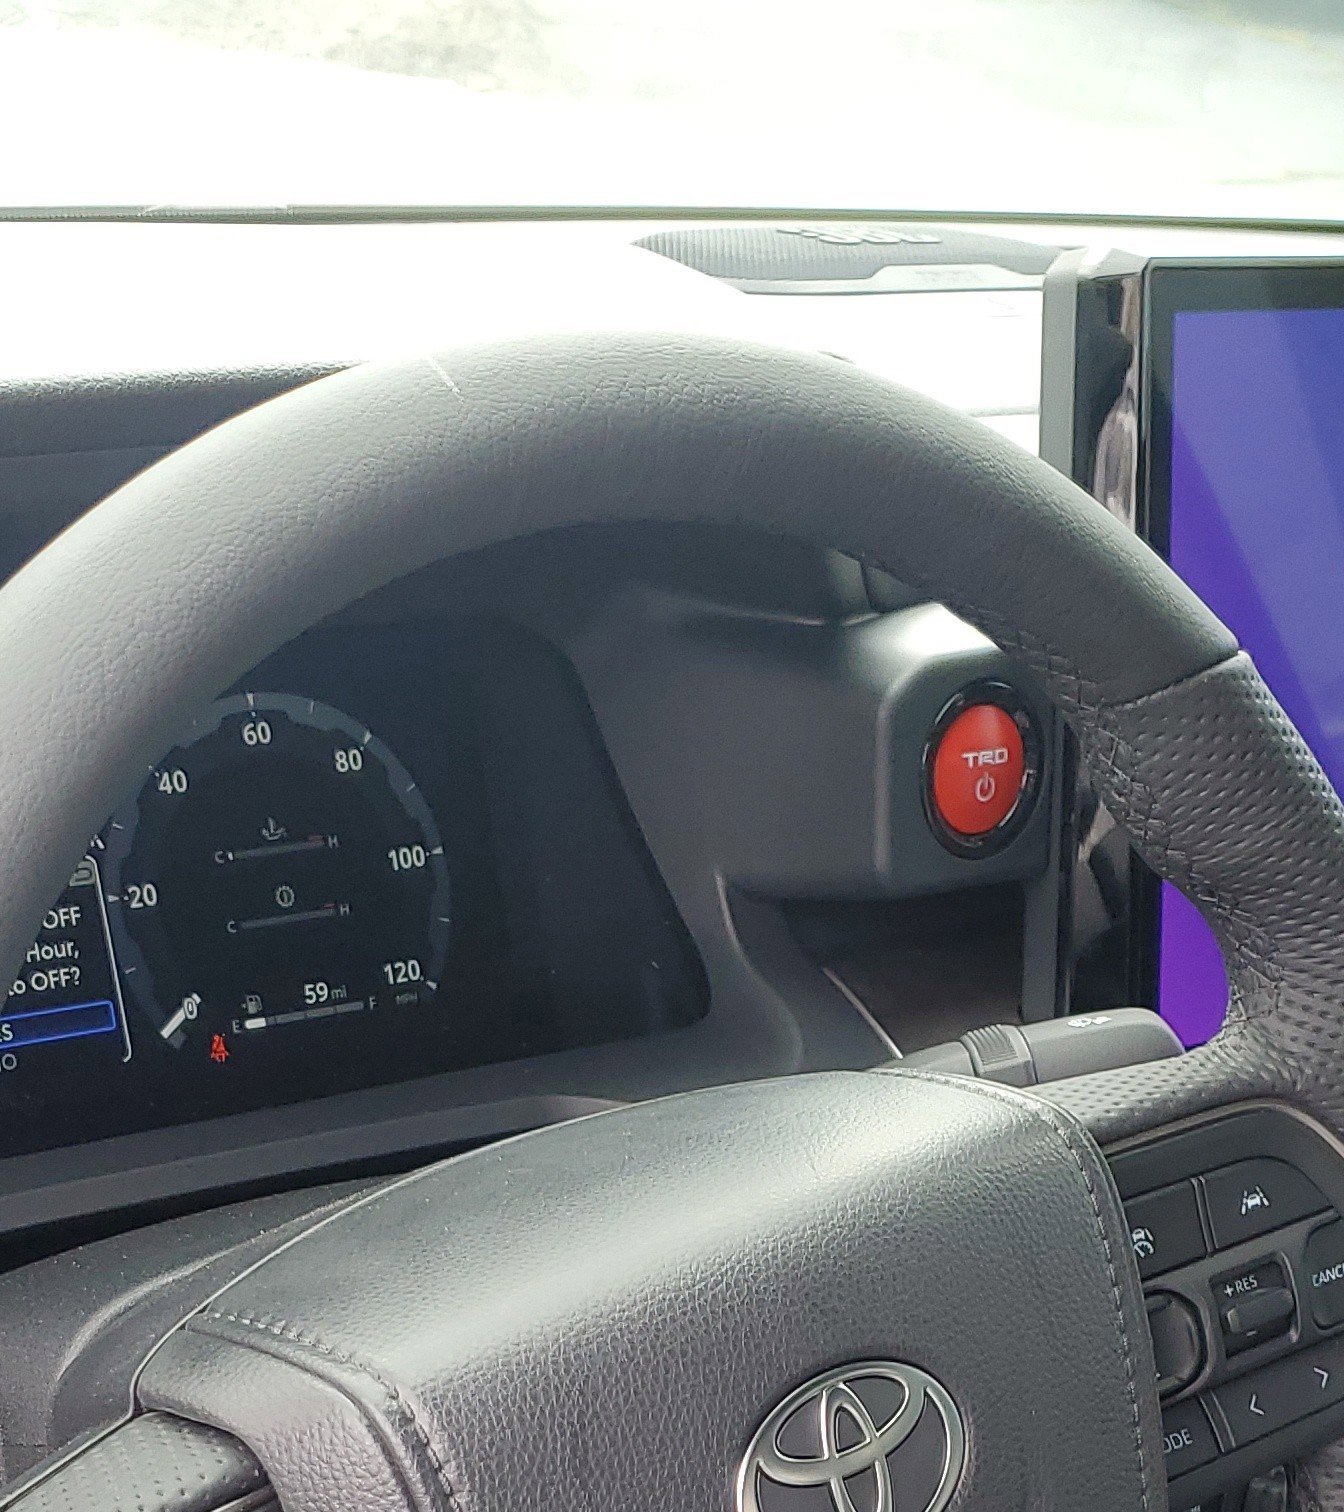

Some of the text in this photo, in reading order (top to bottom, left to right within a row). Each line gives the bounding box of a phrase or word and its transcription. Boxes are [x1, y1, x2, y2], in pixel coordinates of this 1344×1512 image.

[243, 721, 272, 746] 60
[335, 748, 363, 773] 80
[961, 747, 1009, 769] TRD
[158, 769, 188, 795] 40
[214, 834, 340, 865] C H
[387, 846, 427, 872] 100
[129, 884, 158, 910] 20
[42, 906, 82, 930] OFF
[227, 902, 351, 935] C H
[31, 966, 81, 992] OFF?
[383, 959, 421, 986] 120
[304, 981, 347, 1005] 59 mi
[183, 997, 198, 1020] 0
[232, 1018, 243, 1033] E
[369, 996, 378, 1011] F
